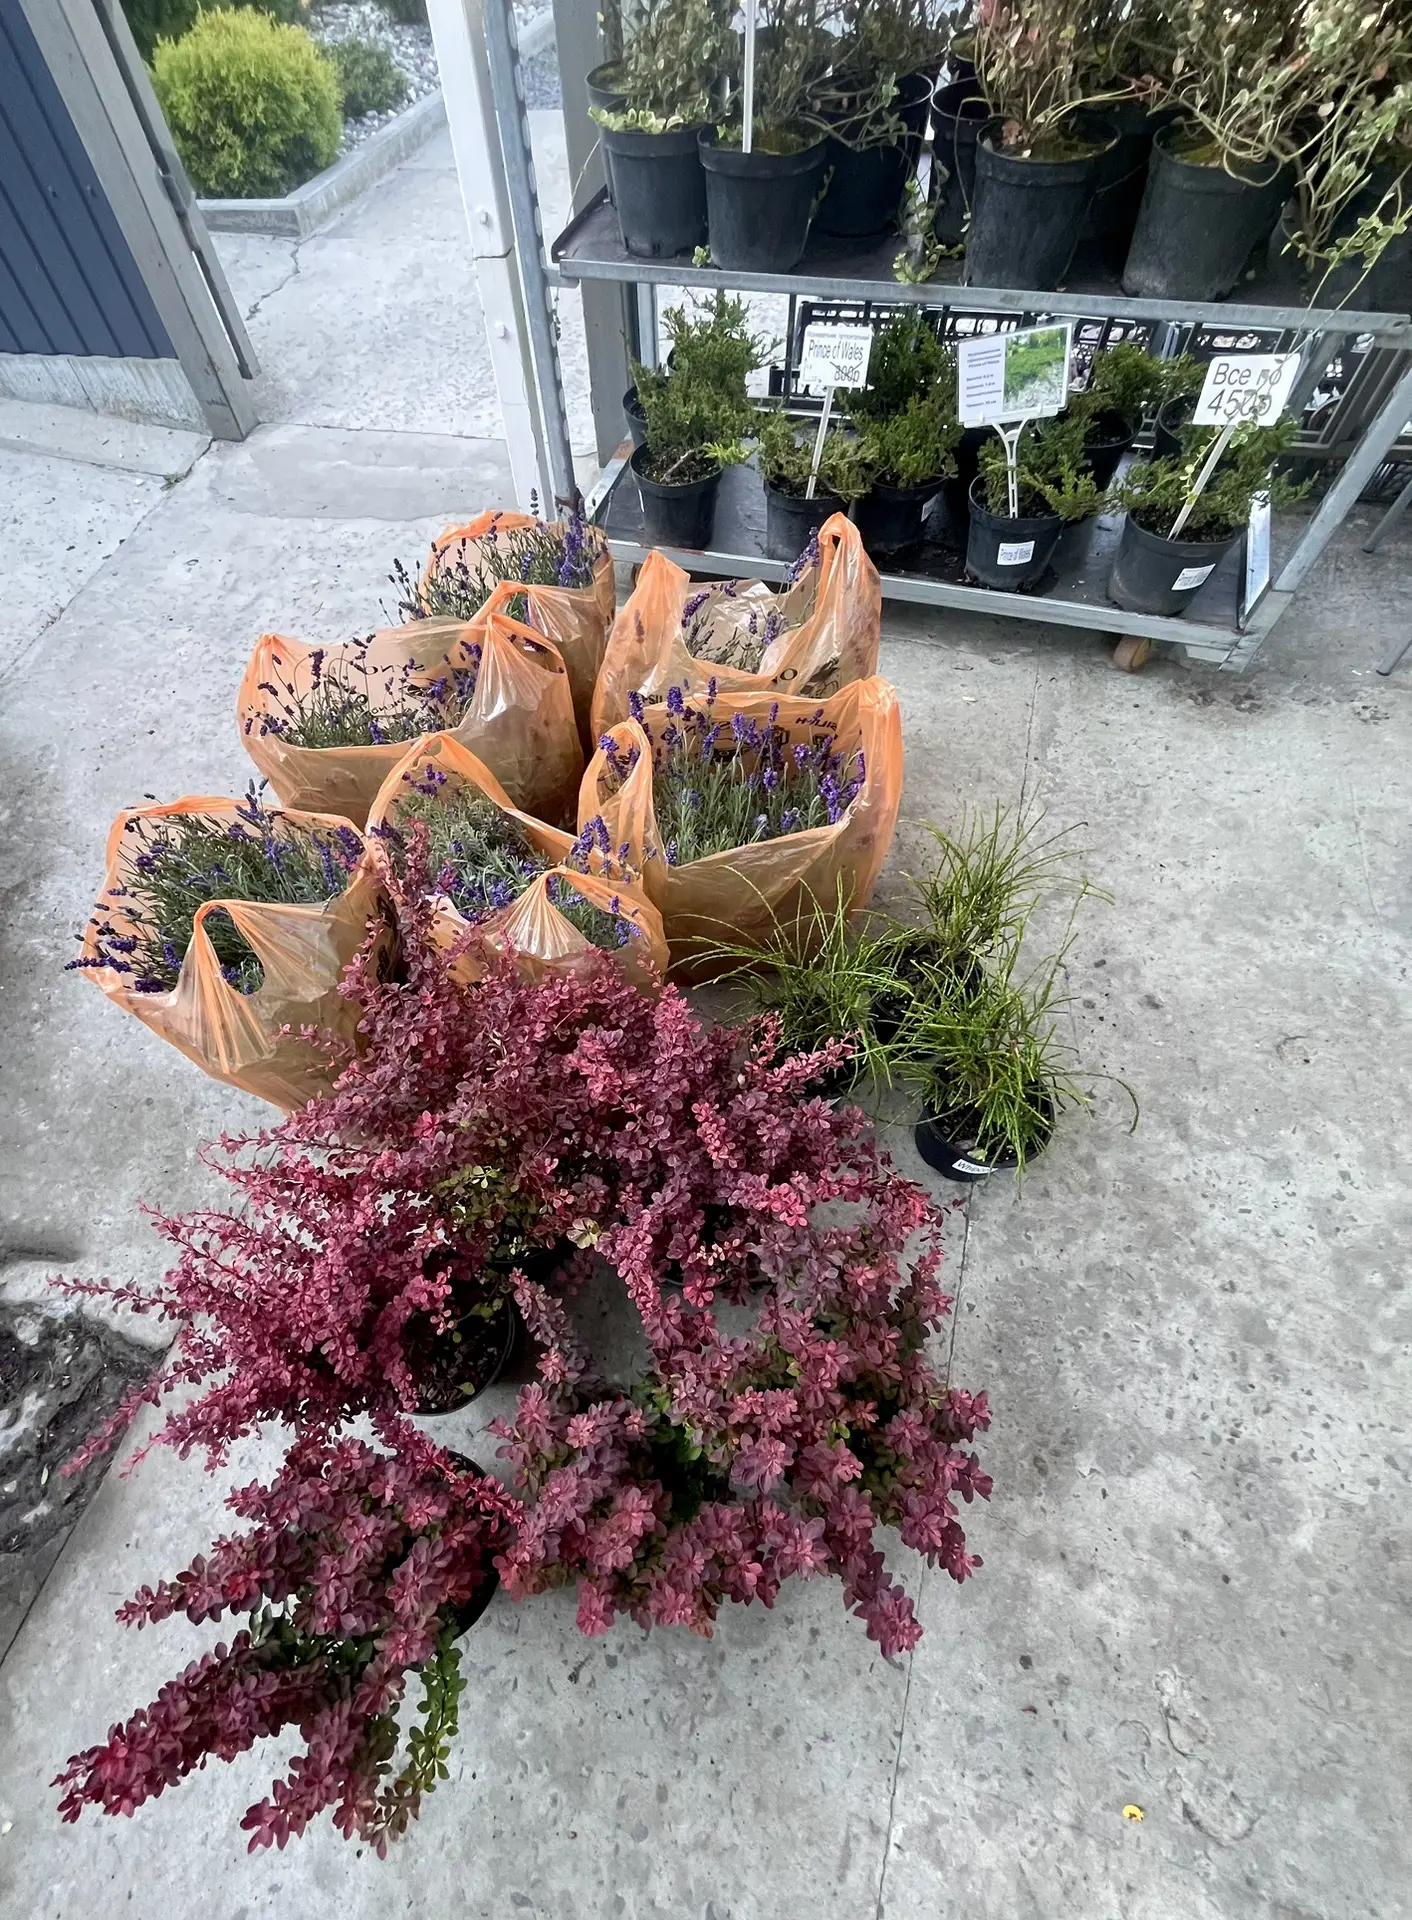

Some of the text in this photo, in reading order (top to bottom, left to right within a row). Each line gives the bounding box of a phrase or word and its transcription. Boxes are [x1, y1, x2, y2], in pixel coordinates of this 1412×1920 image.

[807, 339, 864, 361] Prince of Wales
[1212, 362, 1282, 387] Все по
